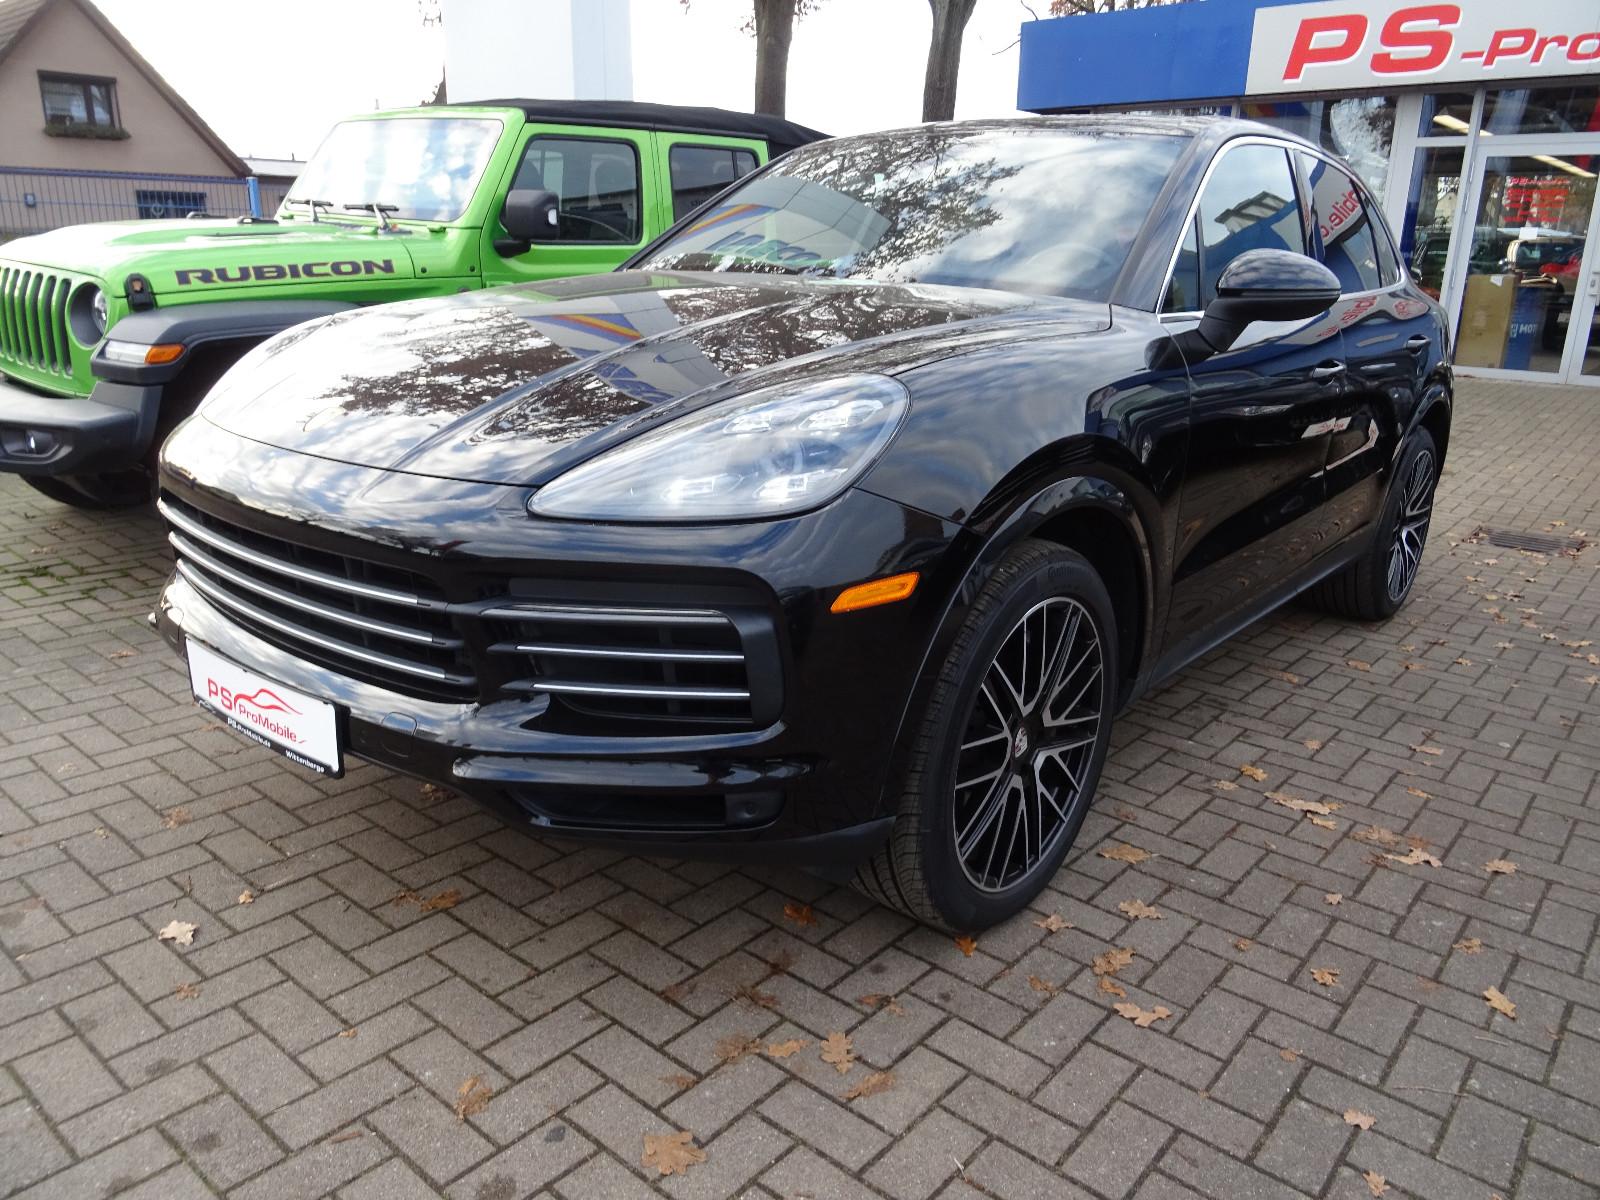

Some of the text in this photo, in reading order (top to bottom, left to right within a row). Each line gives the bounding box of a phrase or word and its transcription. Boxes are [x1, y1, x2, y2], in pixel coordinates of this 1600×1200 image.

[175, 259, 395, 286] RUBICON
[207, 677, 233, 712] PS
[239, 702, 297, 742] ProMobile
